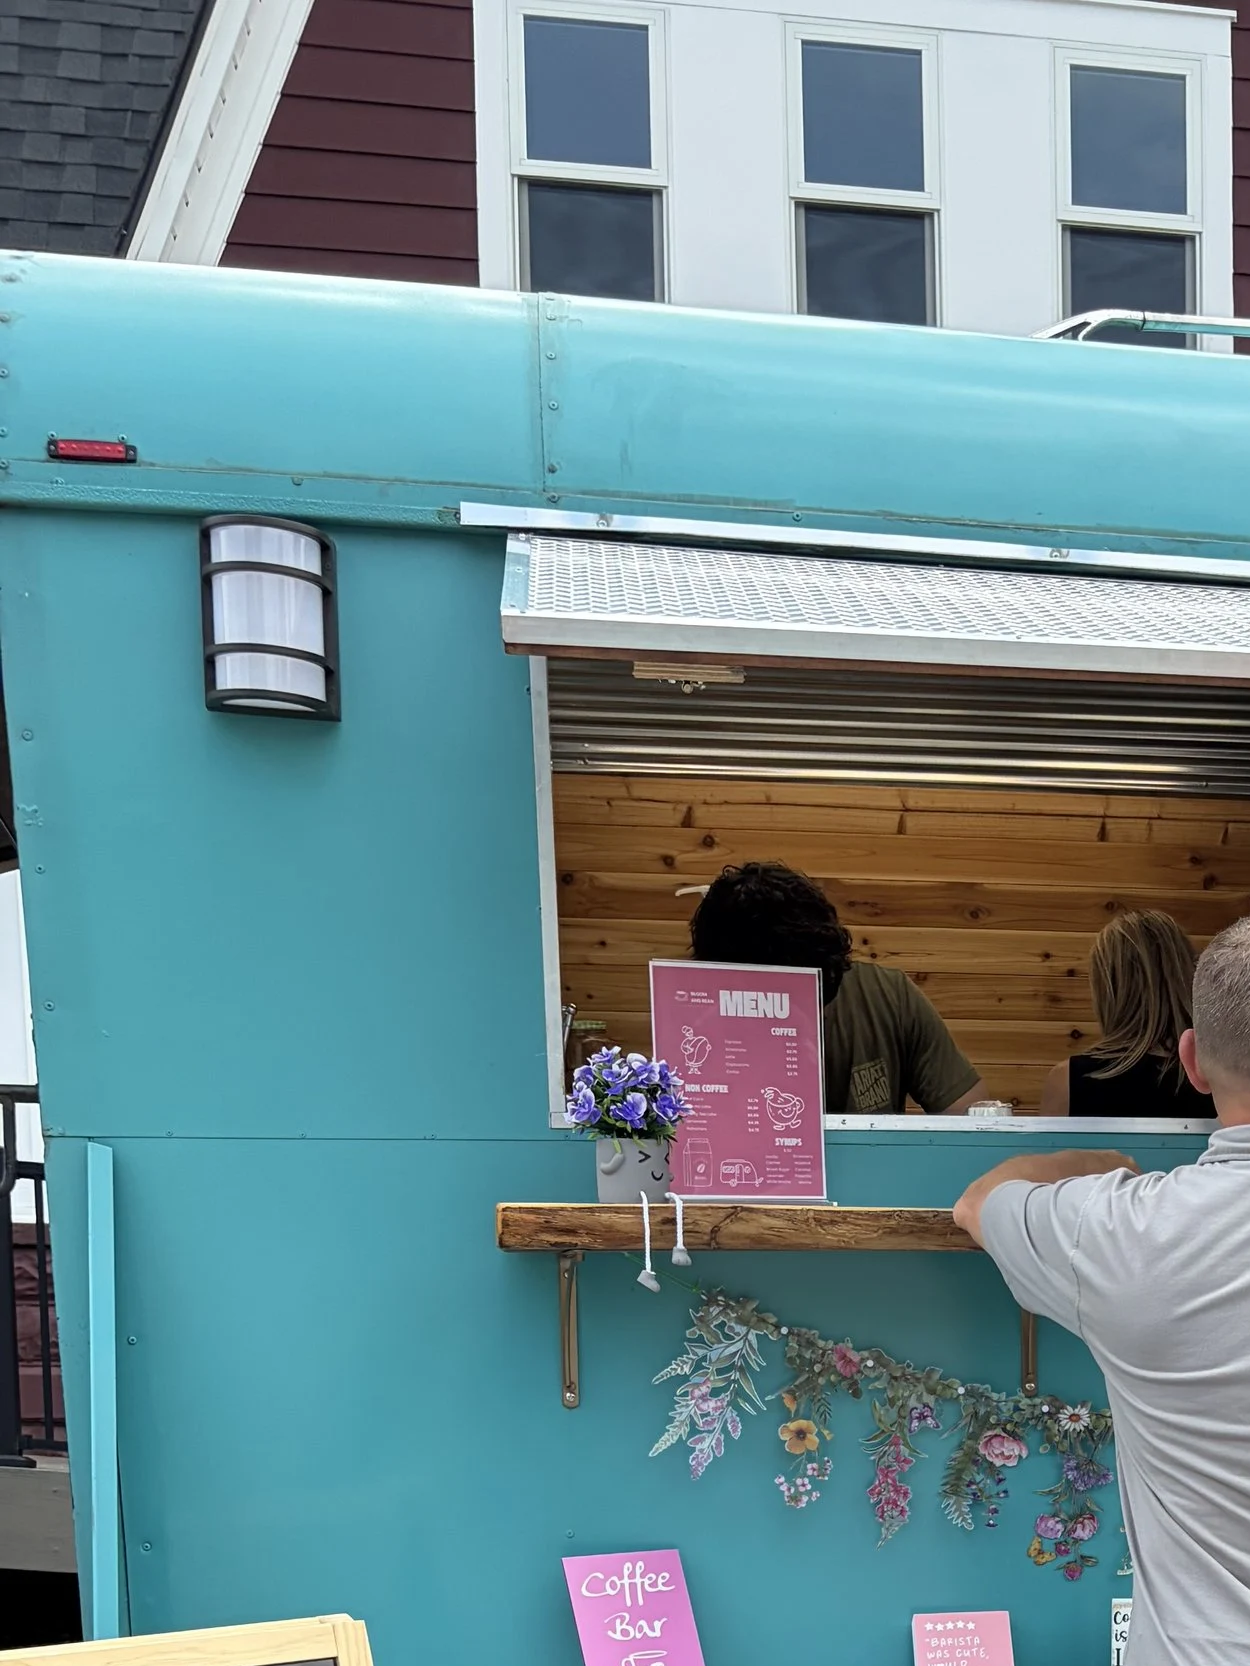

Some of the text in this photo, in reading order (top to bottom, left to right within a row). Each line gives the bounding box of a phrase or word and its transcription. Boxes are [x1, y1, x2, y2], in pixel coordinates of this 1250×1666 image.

[719, 989, 790, 1020] MENU
[770, 1027, 797, 1037] COFFEE
[702, 1084, 729, 1094] COFFEE
[581, 1560, 676, 1607] Coffee
[604, 1612, 668, 1641] Bar
[926, 1647, 989, 1660] WAS CUTE,
